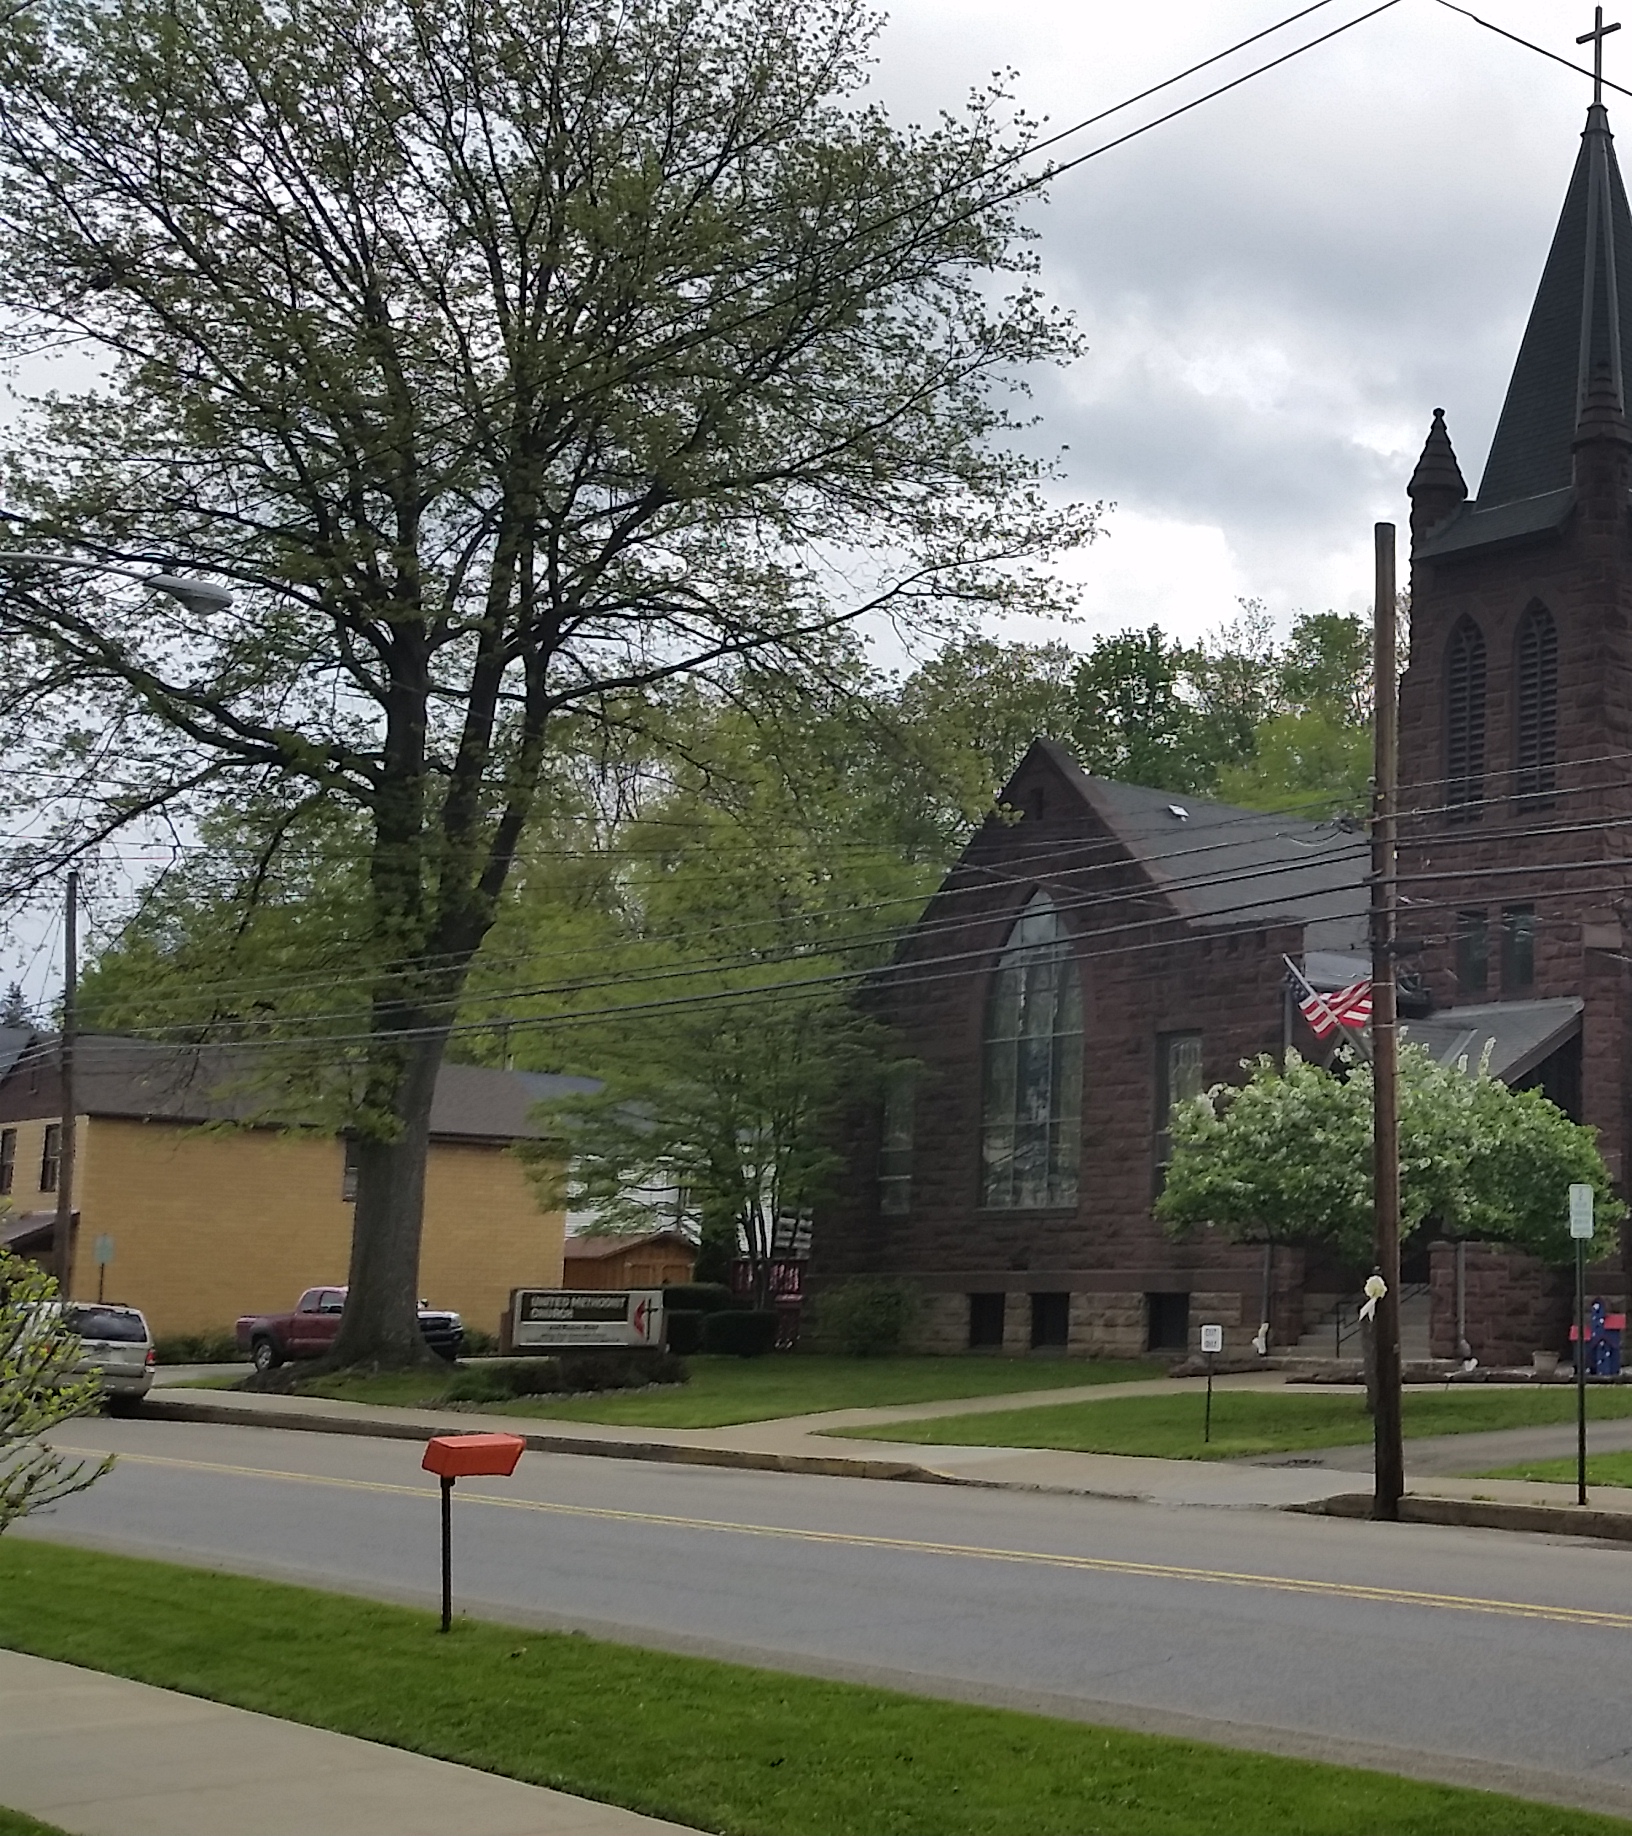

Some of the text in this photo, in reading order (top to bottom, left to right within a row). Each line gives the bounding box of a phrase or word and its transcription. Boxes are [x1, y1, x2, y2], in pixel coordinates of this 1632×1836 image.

[530, 1296, 626, 1308] UNITED METHODIST
[530, 1308, 574, 1319] CHURCH
